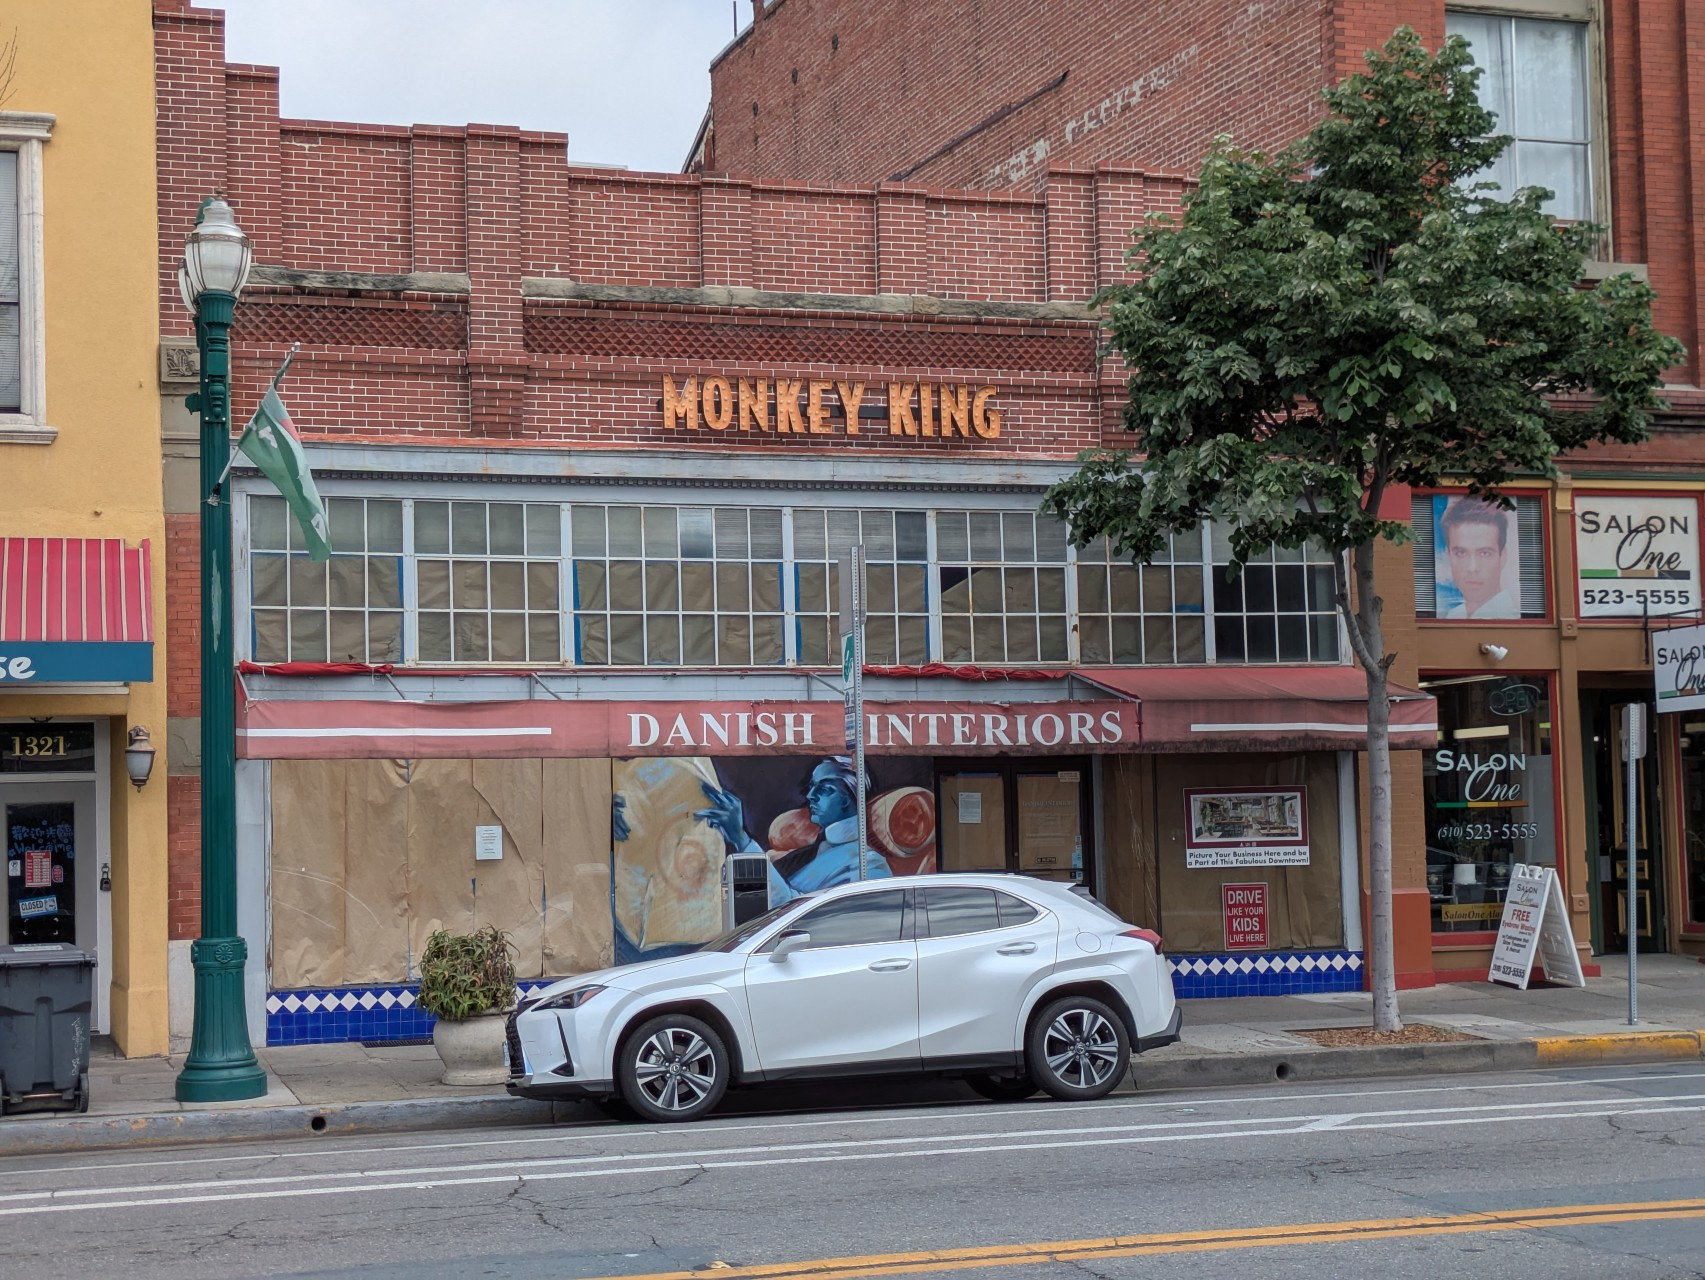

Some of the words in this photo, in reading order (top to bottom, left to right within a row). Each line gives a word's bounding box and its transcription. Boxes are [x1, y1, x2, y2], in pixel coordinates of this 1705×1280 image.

[662, 373, 867, 435] MONKEY
[888, 381, 1001, 439] KING
[1580, 511, 1689, 534] SALON
[1616, 523, 1682, 570] One
[1583, 589, 1690, 605] 523-5555
[1657, 646, 1705, 665] SALO
[1489, 690, 1539, 708] OPEN
[627, 712, 814, 748] DANISH
[867, 709, 1123, 747] INTERIORS
[11, 736, 67, 756] 1321
[1436, 750, 1526, 771] SALON
[1465, 762, 1520, 801] One
[1438, 826, 1463, 839] (510)
[1227, 890, 1263, 904] DRIVE
[1517, 884, 1538, 894] SALON
[21, 901, 43, 911] CLOSED
[1228, 907, 1242, 916] LIKE
[1244, 907, 1264, 915] YOUR
[1512, 909, 1531, 922] FREE
[1232, 917, 1260, 931] KIDS
[1229, 934, 1244, 942] LIVE
[1246, 933, 1264, 942] HERE
[1502, 964, 1526, 978] 523-5555
